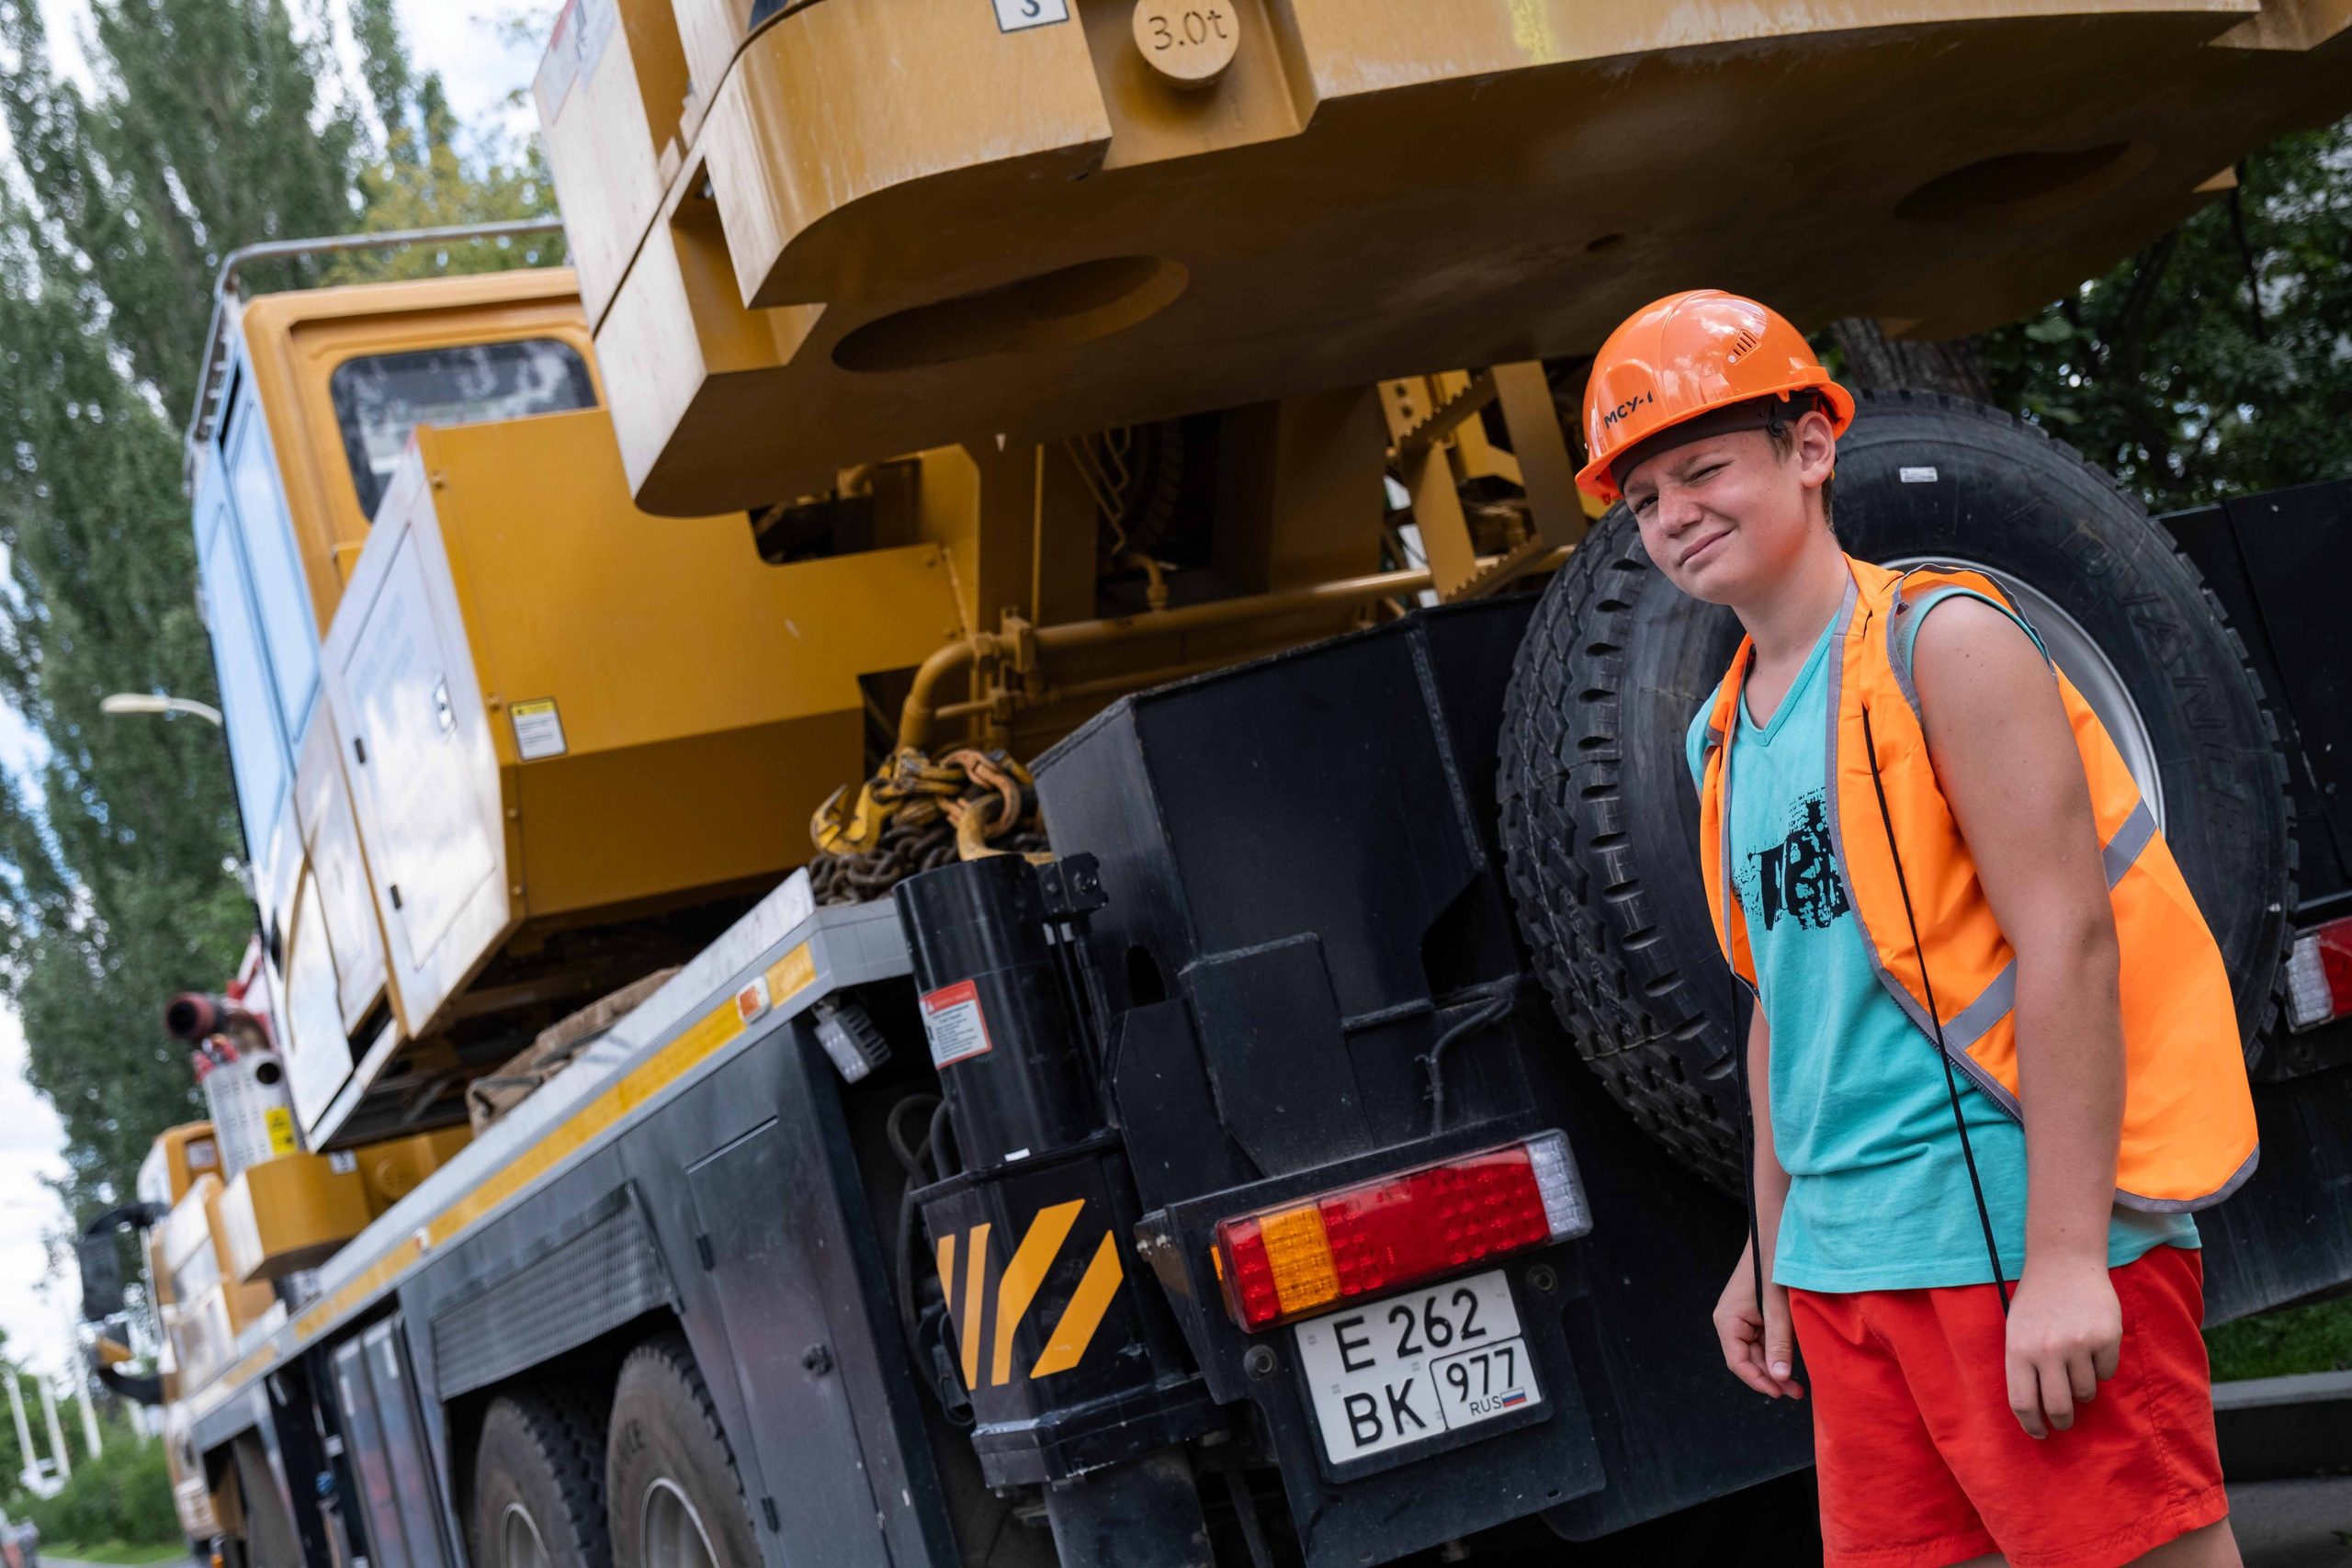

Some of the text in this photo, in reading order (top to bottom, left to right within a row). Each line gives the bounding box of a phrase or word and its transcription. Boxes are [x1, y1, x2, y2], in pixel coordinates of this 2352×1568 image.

[1148, 10, 1227, 51] 3.0t
[1388, 1288, 1487, 1359] 262
[1446, 1347, 1514, 1404] 977
[1470, 1395, 1502, 1416] RUS
